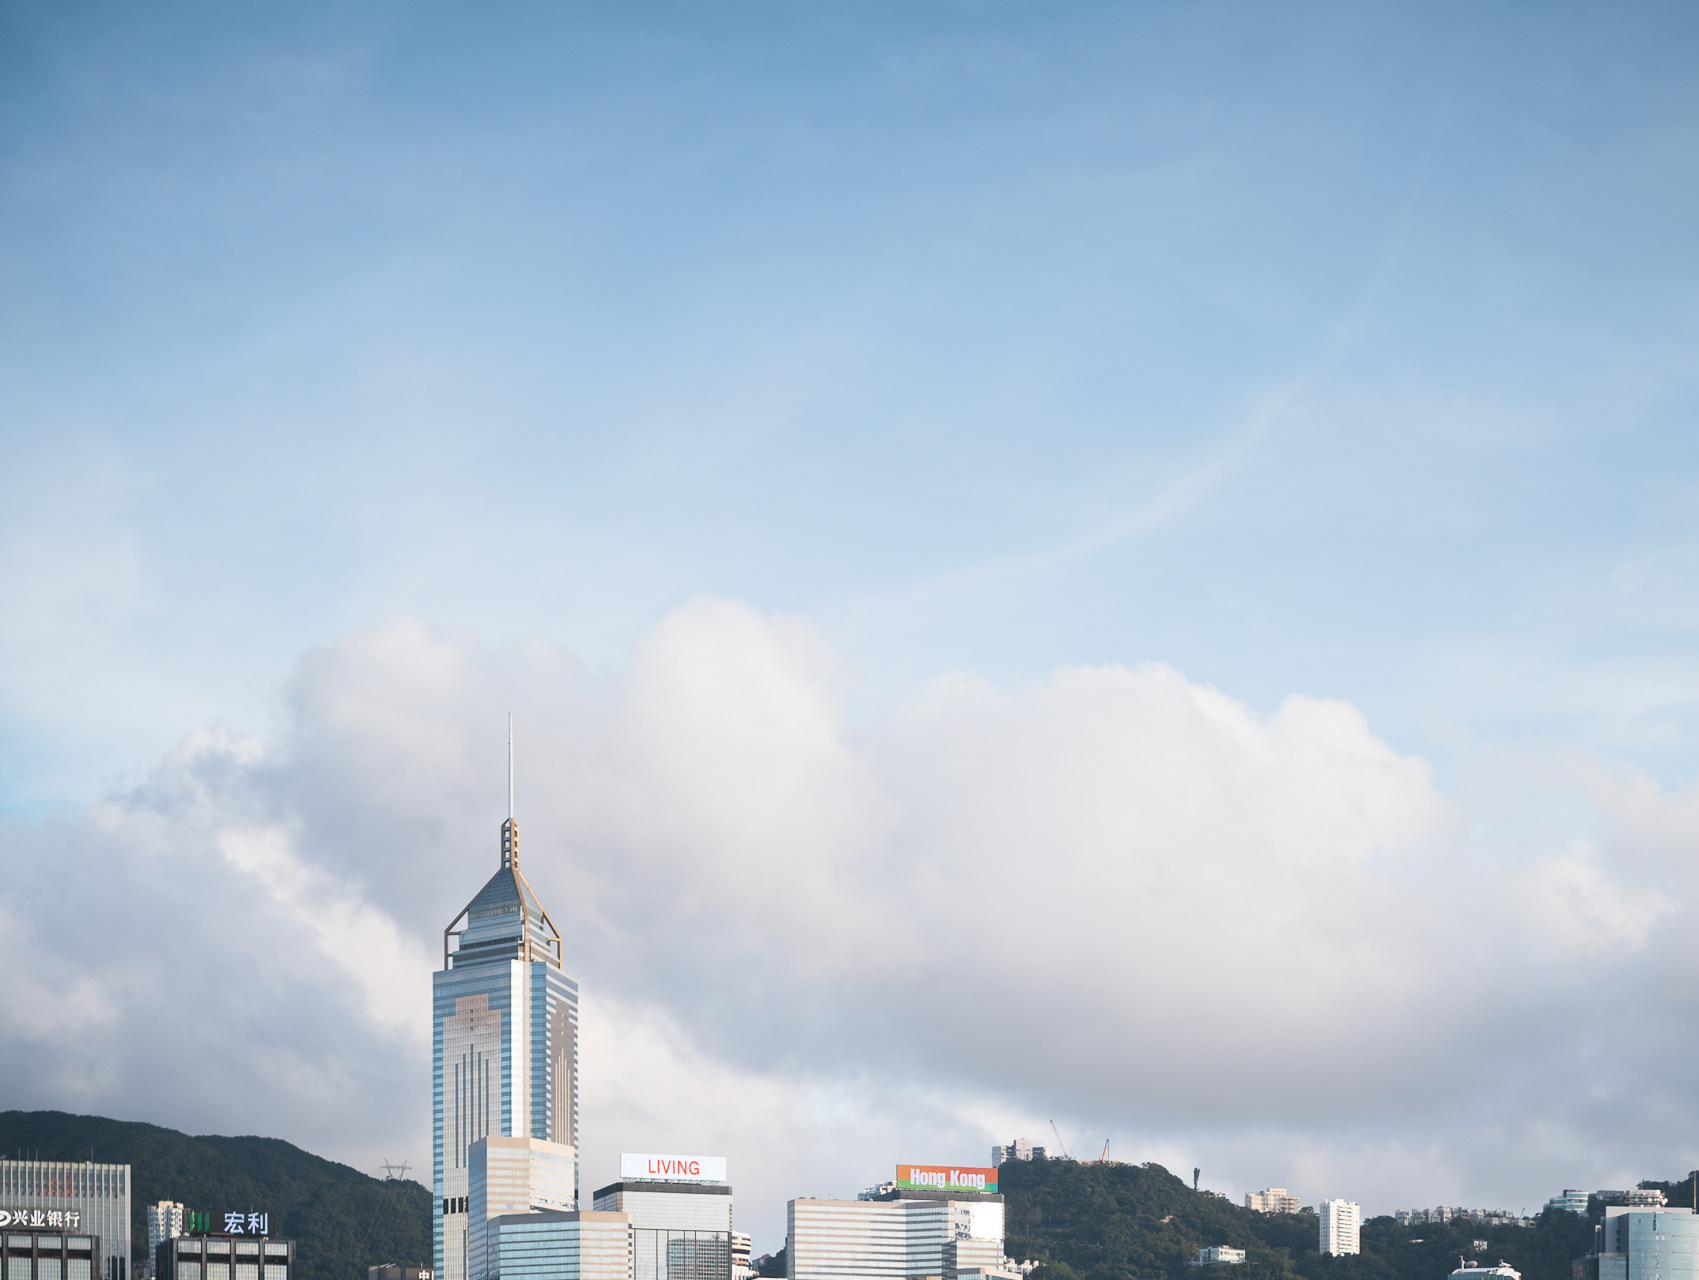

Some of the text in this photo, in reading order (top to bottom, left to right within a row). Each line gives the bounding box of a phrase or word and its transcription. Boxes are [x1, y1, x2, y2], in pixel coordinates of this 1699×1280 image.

[648, 1159, 700, 1175] LIVING
[910, 1168, 985, 1190] Hong Kong
[12, 1209, 80, 1227] 兴业银行
[224, 1211, 268, 1234] 宏利
